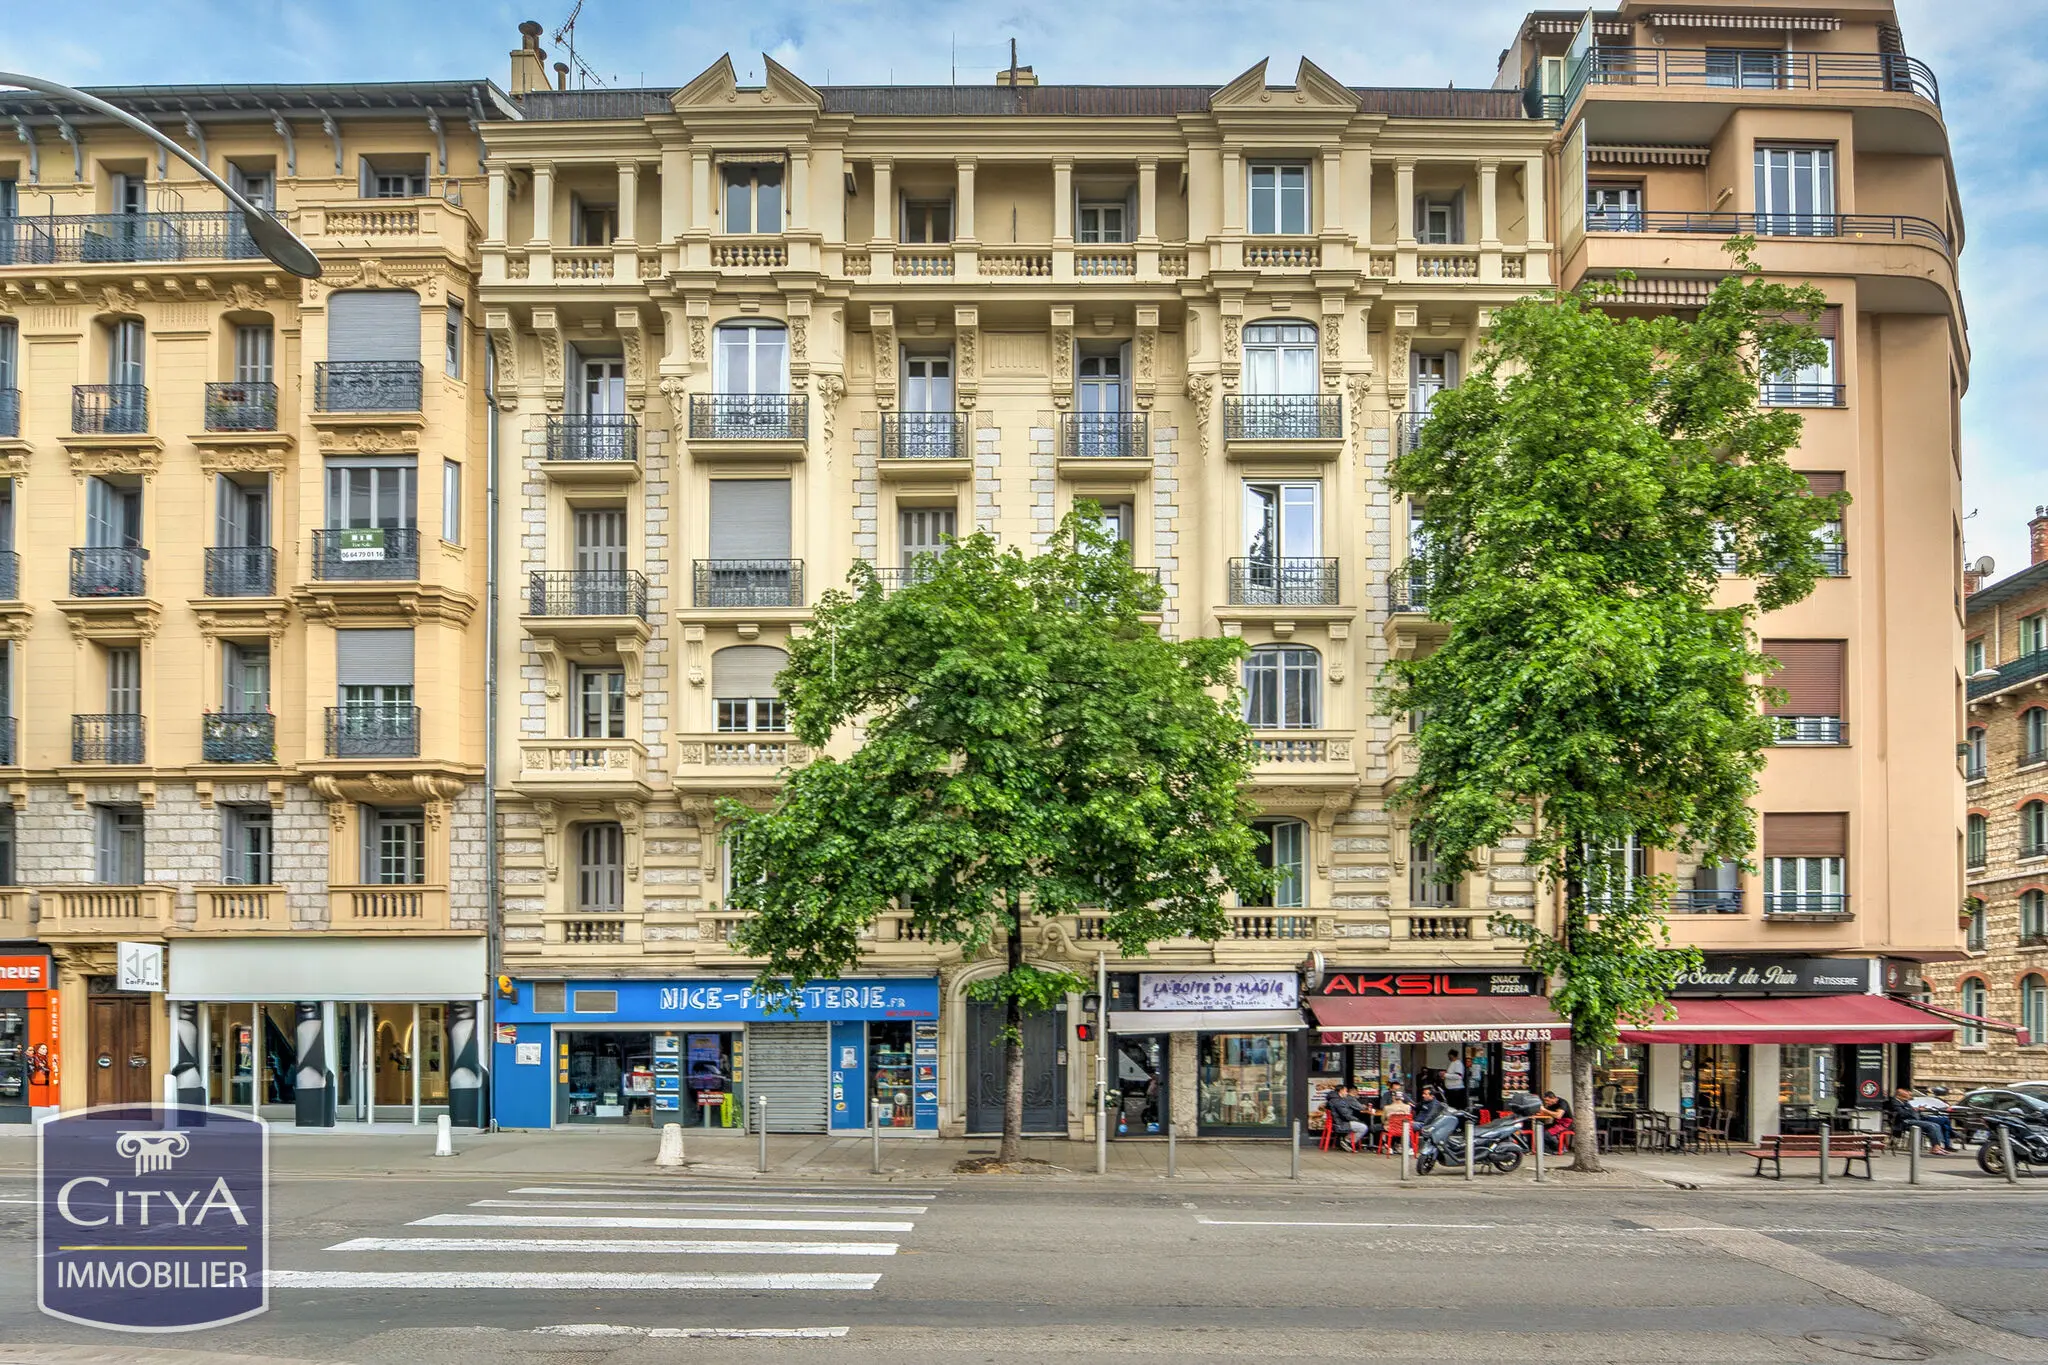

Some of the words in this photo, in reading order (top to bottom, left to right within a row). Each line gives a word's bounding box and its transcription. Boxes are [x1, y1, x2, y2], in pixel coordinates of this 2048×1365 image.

[1490, 975, 1521, 984] SNACK
[1688, 965, 1738, 985] Secret
[1738, 967, 1760, 985] du
[1761, 965, 1799, 985] Pain
[1323, 974, 1478, 995] AKSIL
[1490, 984, 1530, 993] PIZZERIA
[1342, 1031, 1376, 1043] PIZZAS
[1383, 1031, 1416, 1042] TACOS
[1422, 1030, 1481, 1042] SANDWICHS
